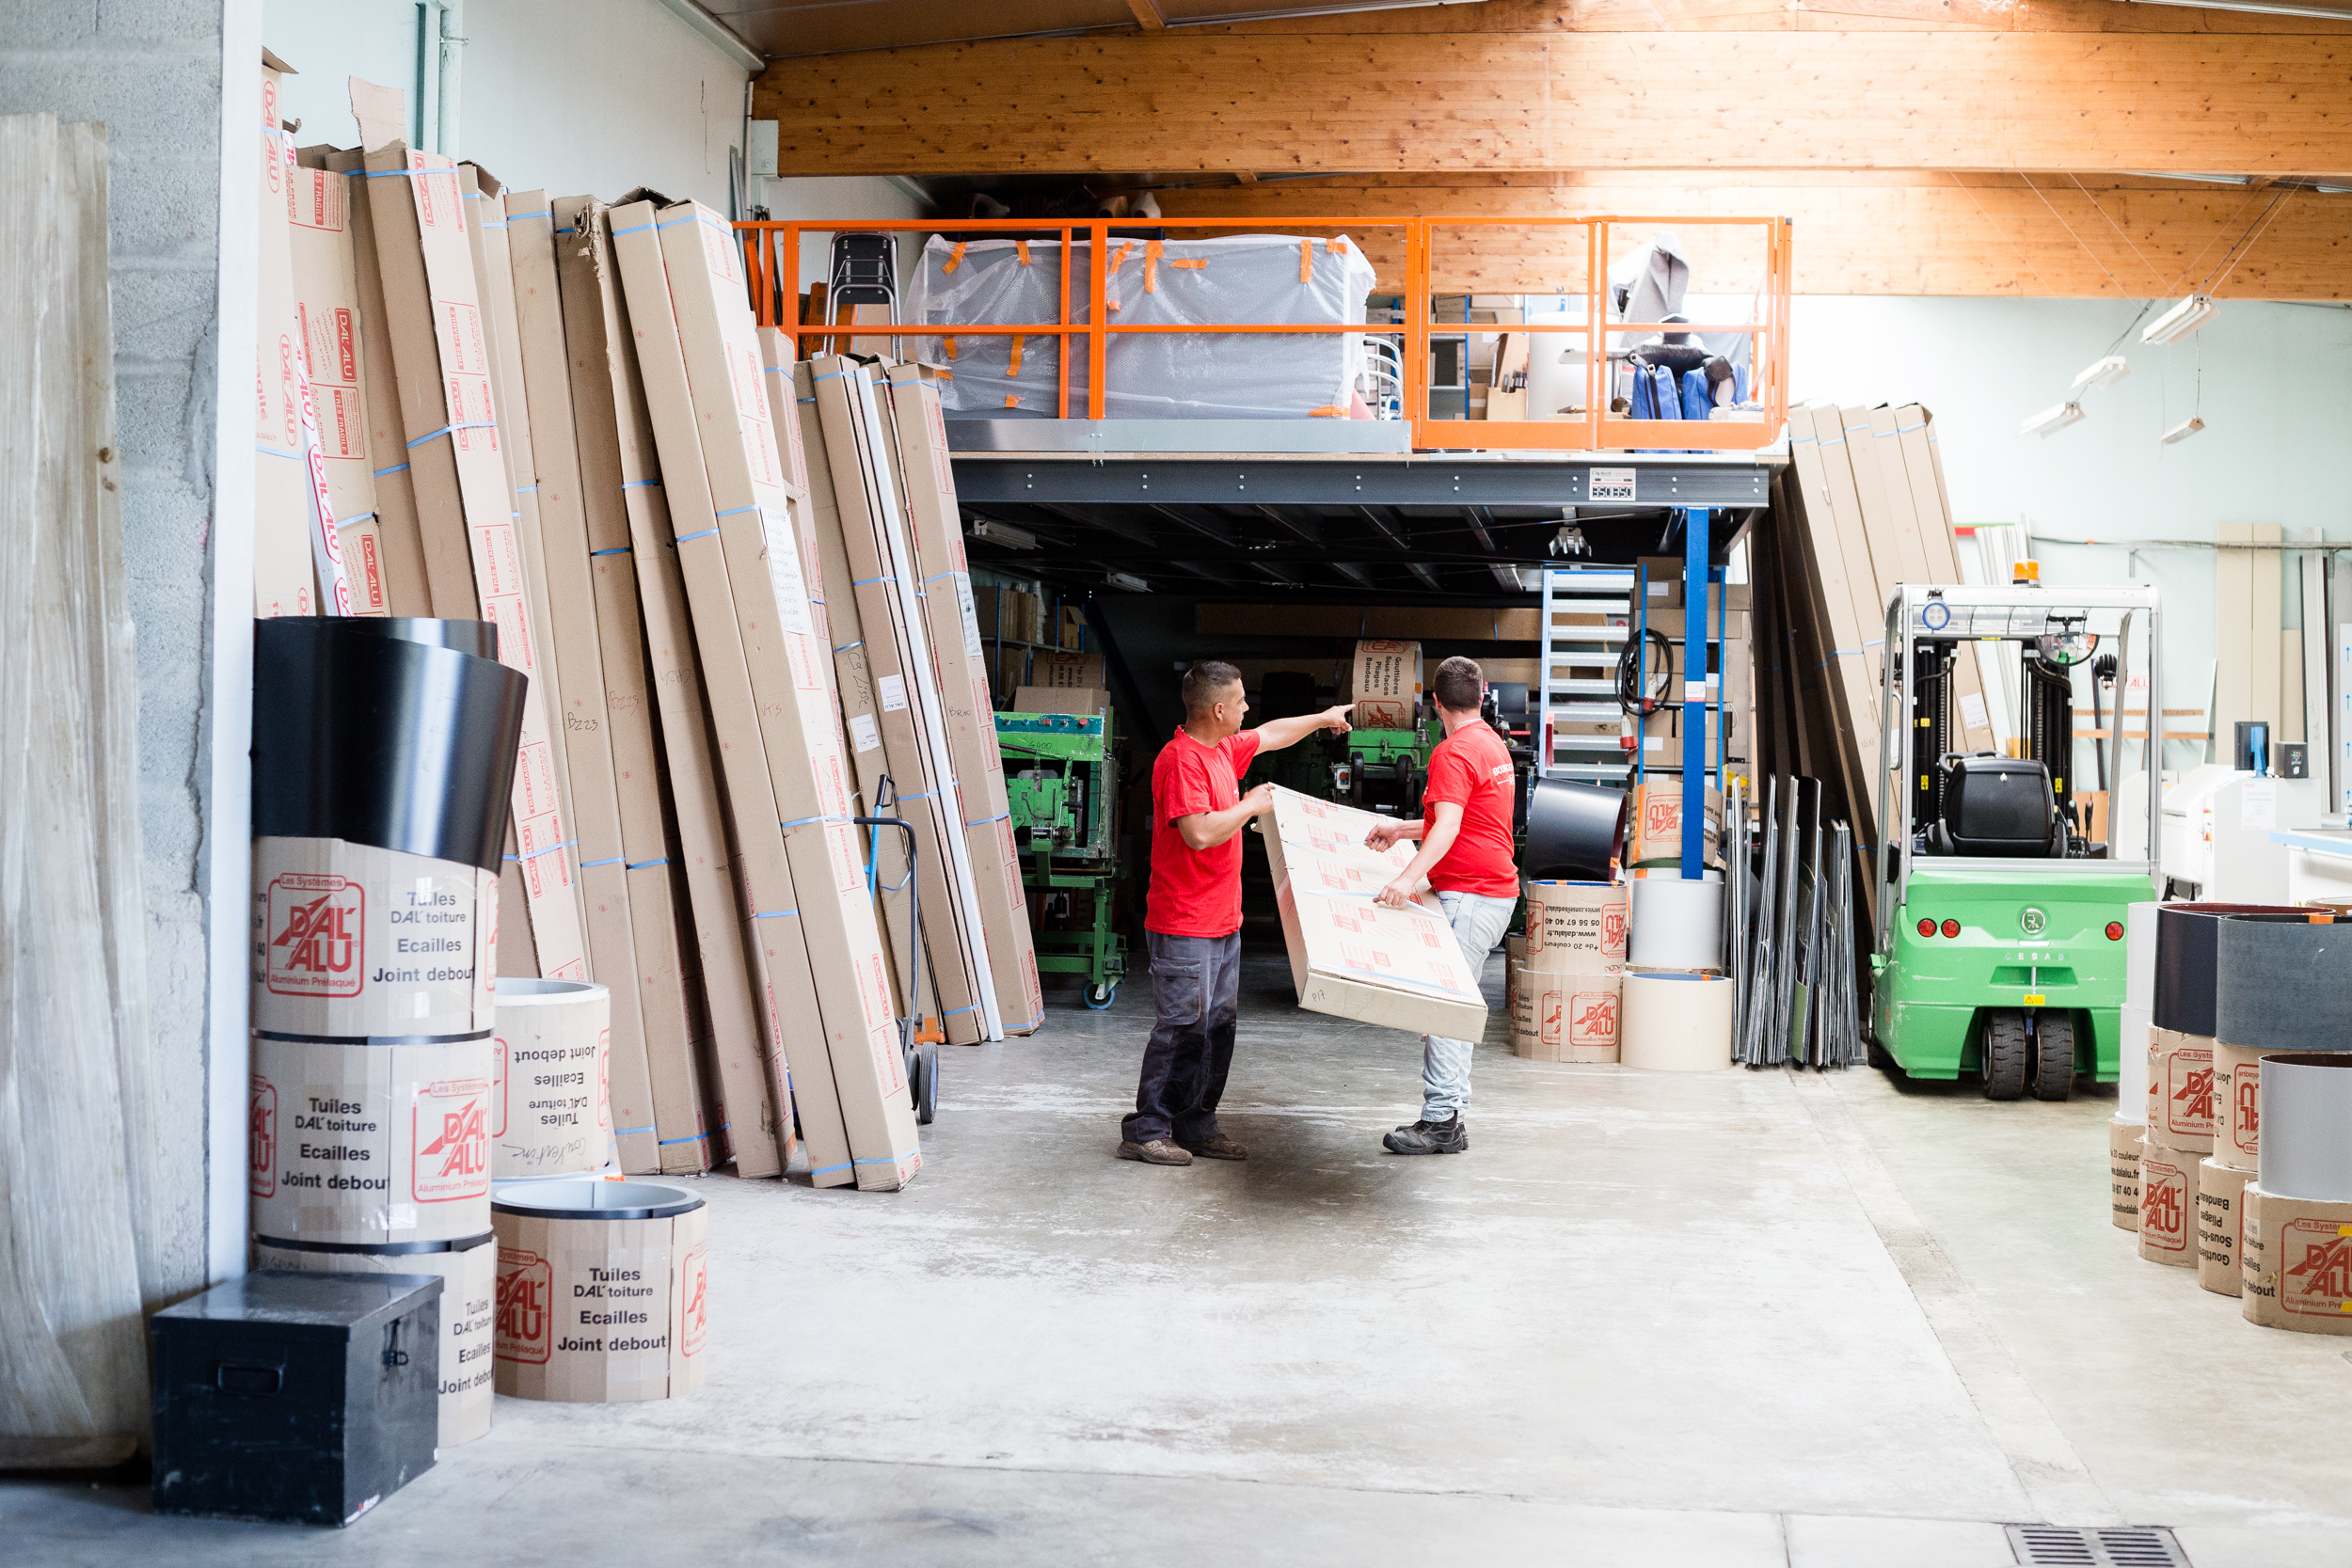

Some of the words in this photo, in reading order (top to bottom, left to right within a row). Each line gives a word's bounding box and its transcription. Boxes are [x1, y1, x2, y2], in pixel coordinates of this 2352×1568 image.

[342, 351, 353, 376] ALU
[453, 384, 463, 413] ALU
[284, 395, 295, 435] ALU
[338, 417, 347, 451] FRAGILE
[324, 504, 339, 550] ALU
[369, 573, 381, 602] ALU
[1364, 657, 1373, 693] Bandeaux
[1374, 661, 1382, 689] Pliages
[1384, 656, 1392, 696] Sous-faces
[1393, 657, 1402, 695] Gouttières
[1649, 804, 1681, 816] ALU
[282, 877, 294, 885] Les
[296, 877, 342, 888] Systèmes
[290, 905, 357, 939] DAL'
[426, 911, 466, 923] toiture
[397, 939, 462, 953] Ecailles
[286, 940, 353, 973] ALU
[2005, 952, 2064, 960] CESAB
[271, 975, 309, 986] Aluminium
[311, 976, 356, 988] Prélaqué
[373, 967, 420, 982] Joint
[1585, 1006, 1615, 1022] DAL'
[1584, 1021, 1614, 1036] ALU
[515, 1049, 566, 1064] debout
[570, 1046, 596, 1059] Joint
[2192, 1052, 2213, 1061] Systè
[534, 1072, 584, 1087] Ecailles
[309, 1098, 361, 1114] Tuiles
[529, 1099, 565, 1110] toiture
[295, 1116, 325, 1129] DAL'
[326, 1119, 376, 1132] toiture
[443, 1105, 487, 1145] DAL'
[541, 1112, 579, 1125] Tuiles
[2171, 1119, 2204, 1128] Aluminium
[300, 1144, 370, 1161] Ecailles
[438, 1139, 485, 1177] ALU
[2119, 1151, 2139, 1161] couleur
[282, 1171, 321, 1188] Joint
[418, 1179, 462, 1194] Aluminium
[2123, 1186, 2132, 1196] 40
[2146, 1182, 2183, 1211] DAL'
[2145, 1210, 2180, 1233] ALU
[2297, 1220, 2312, 1228] Les
[2314, 1222, 2341, 1231] Systè
[2157, 1234, 2183, 1244] Prélaqué
[2306, 1244, 2352, 1271] DA
[589, 1267, 641, 1282] Tuiles
[574, 1285, 607, 1298] DAL'
[608, 1286, 653, 1298] toiture
[2248, 1280, 2276, 1297] debout
[466, 1299, 488, 1316] Tuiles
[2285, 1296, 2327, 1307] Aluminium
[474, 1316, 492, 1331] toitur
[496, 1308, 541, 1341] ALU
[580, 1310, 648, 1325] Ecailles
[510, 1343, 545, 1356] Prélaqué
[558, 1338, 602, 1352] Joint
[609, 1335, 666, 1352] debout
[459, 1343, 491, 1364] Ecailles
[438, 1377, 470, 1395] Joint
[474, 1369, 493, 1386] debo
